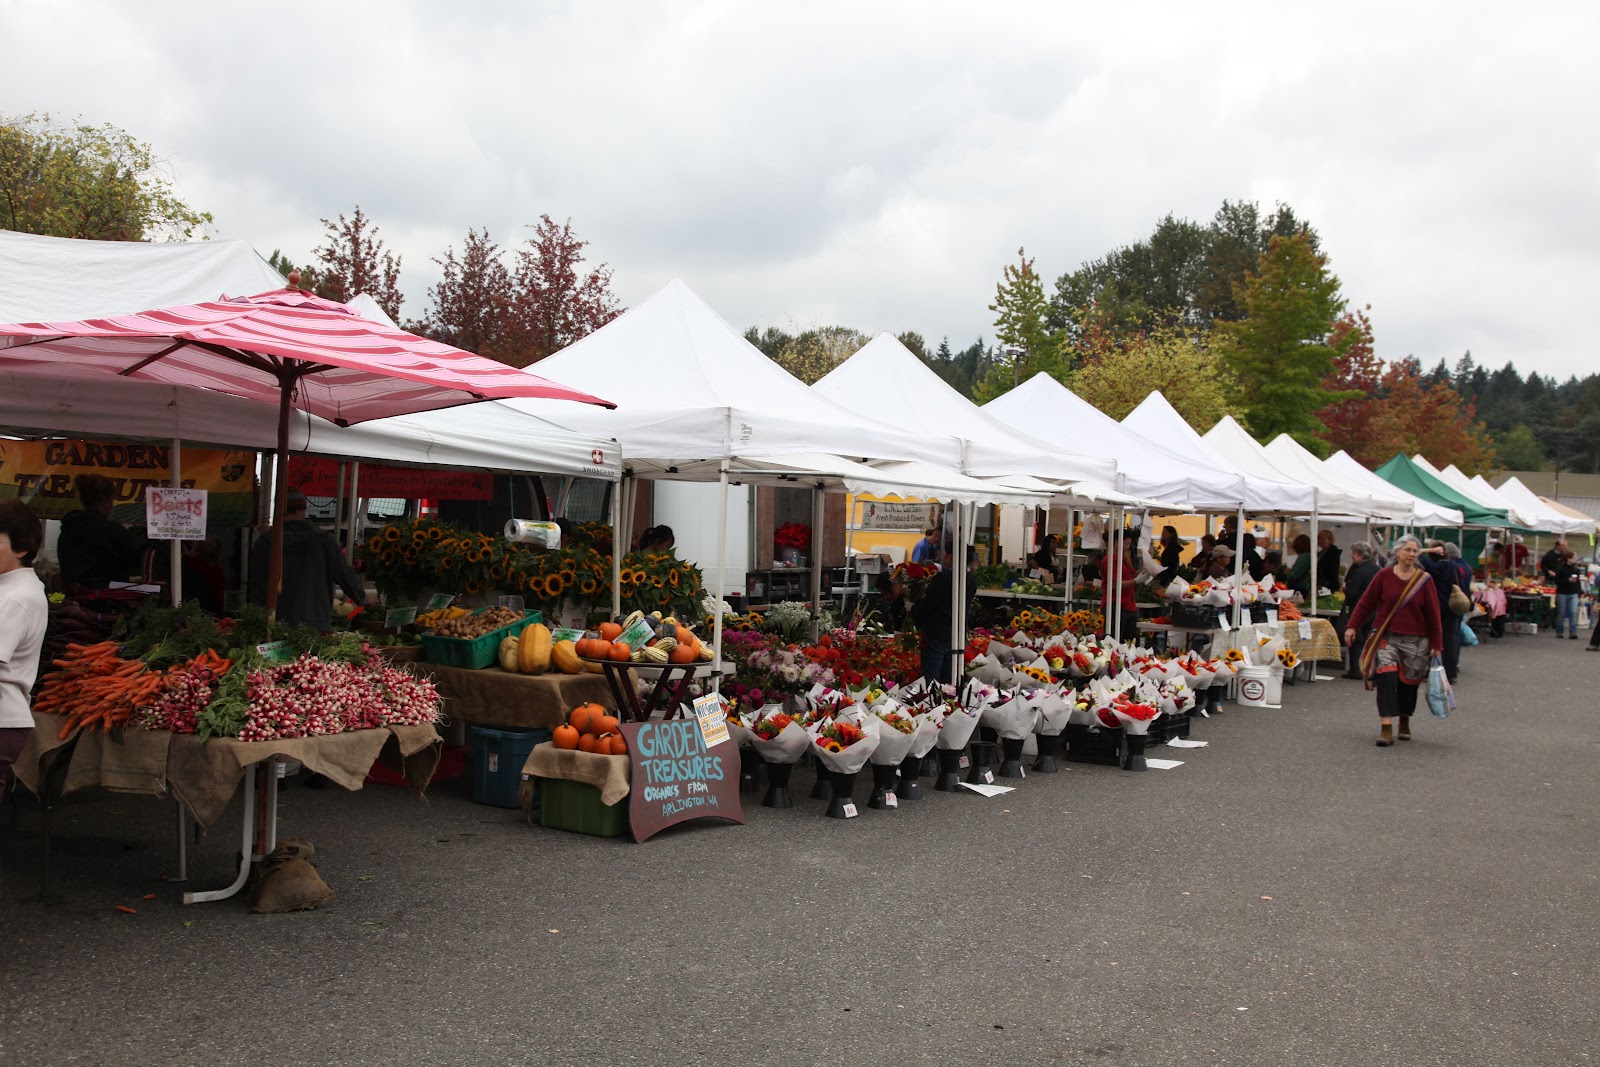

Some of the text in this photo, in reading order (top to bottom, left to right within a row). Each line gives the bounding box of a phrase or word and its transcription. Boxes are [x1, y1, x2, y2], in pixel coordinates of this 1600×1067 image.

[46, 443, 169, 469] GARDEN
[318, 470, 341, 482] Fres
[582, 466, 615, 477] SWISSGEAR
[15, 473, 196, 502] TREUR
[152, 491, 203, 517] Beets
[638, 721, 707, 758] GARDEN
[640, 755, 724, 784] TREASURES
[687, 781, 709, 794] FROM
[707, 794, 719, 808] WA
